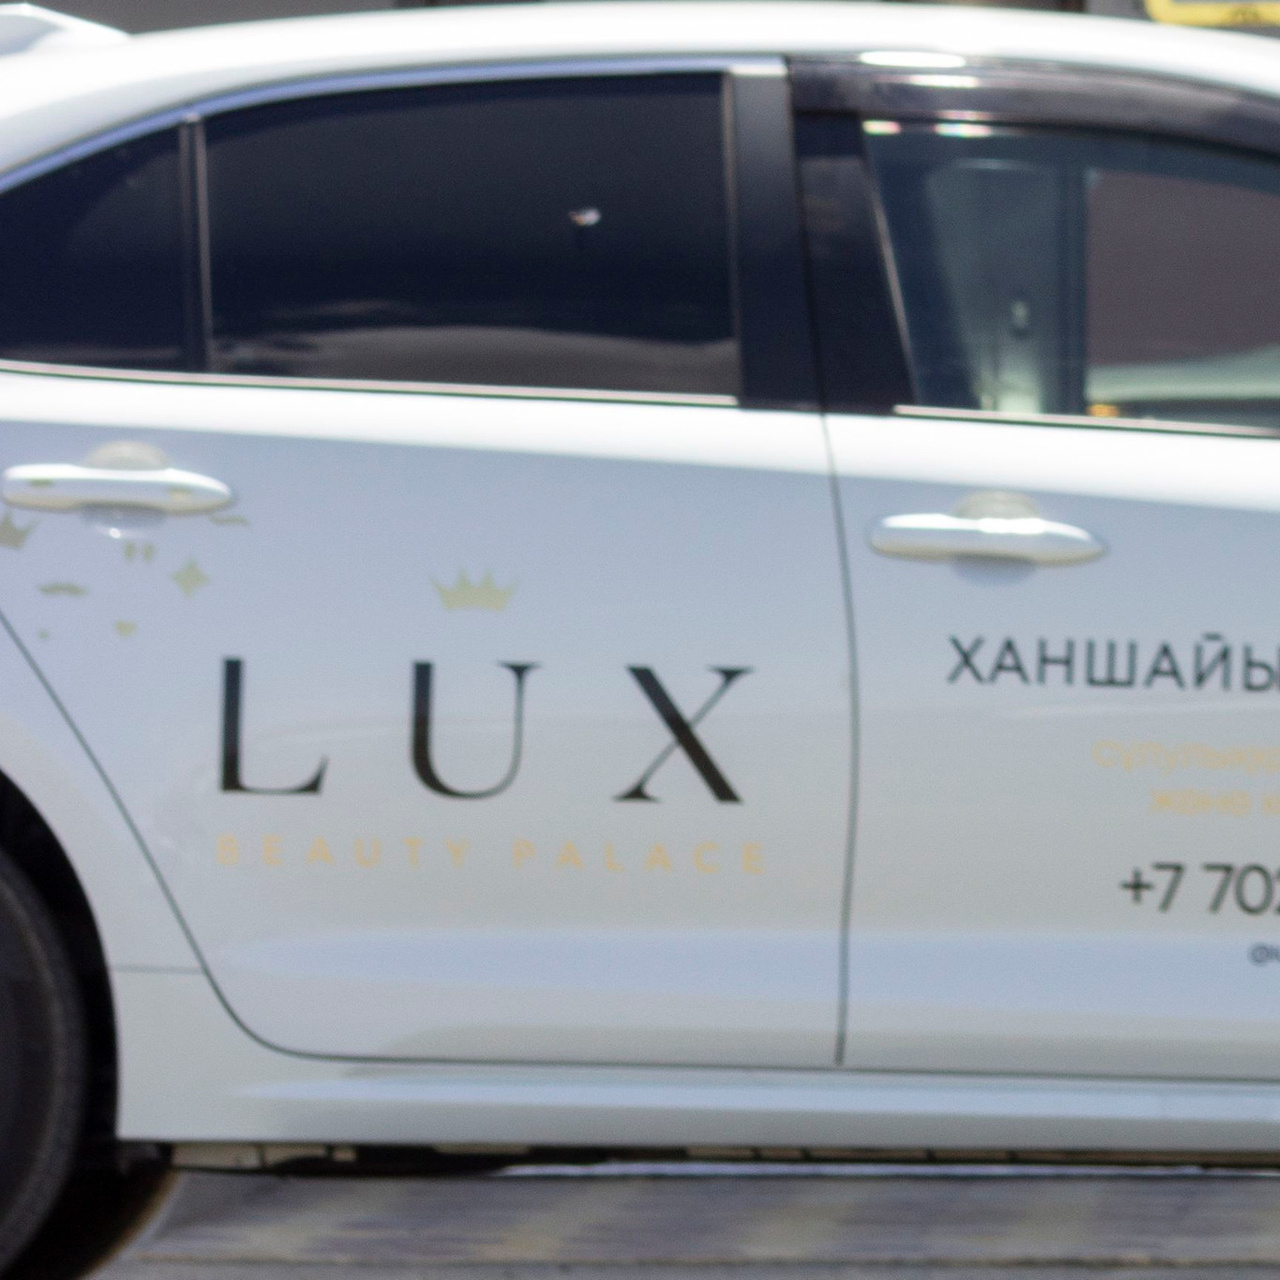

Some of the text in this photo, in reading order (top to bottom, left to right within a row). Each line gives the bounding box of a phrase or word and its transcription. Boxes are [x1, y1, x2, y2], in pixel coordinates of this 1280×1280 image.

[218, 656, 756, 805] LUX
[214, 832, 768, 876] BEAUTY PALACE
[1118, 861, 1186, 914] +7
